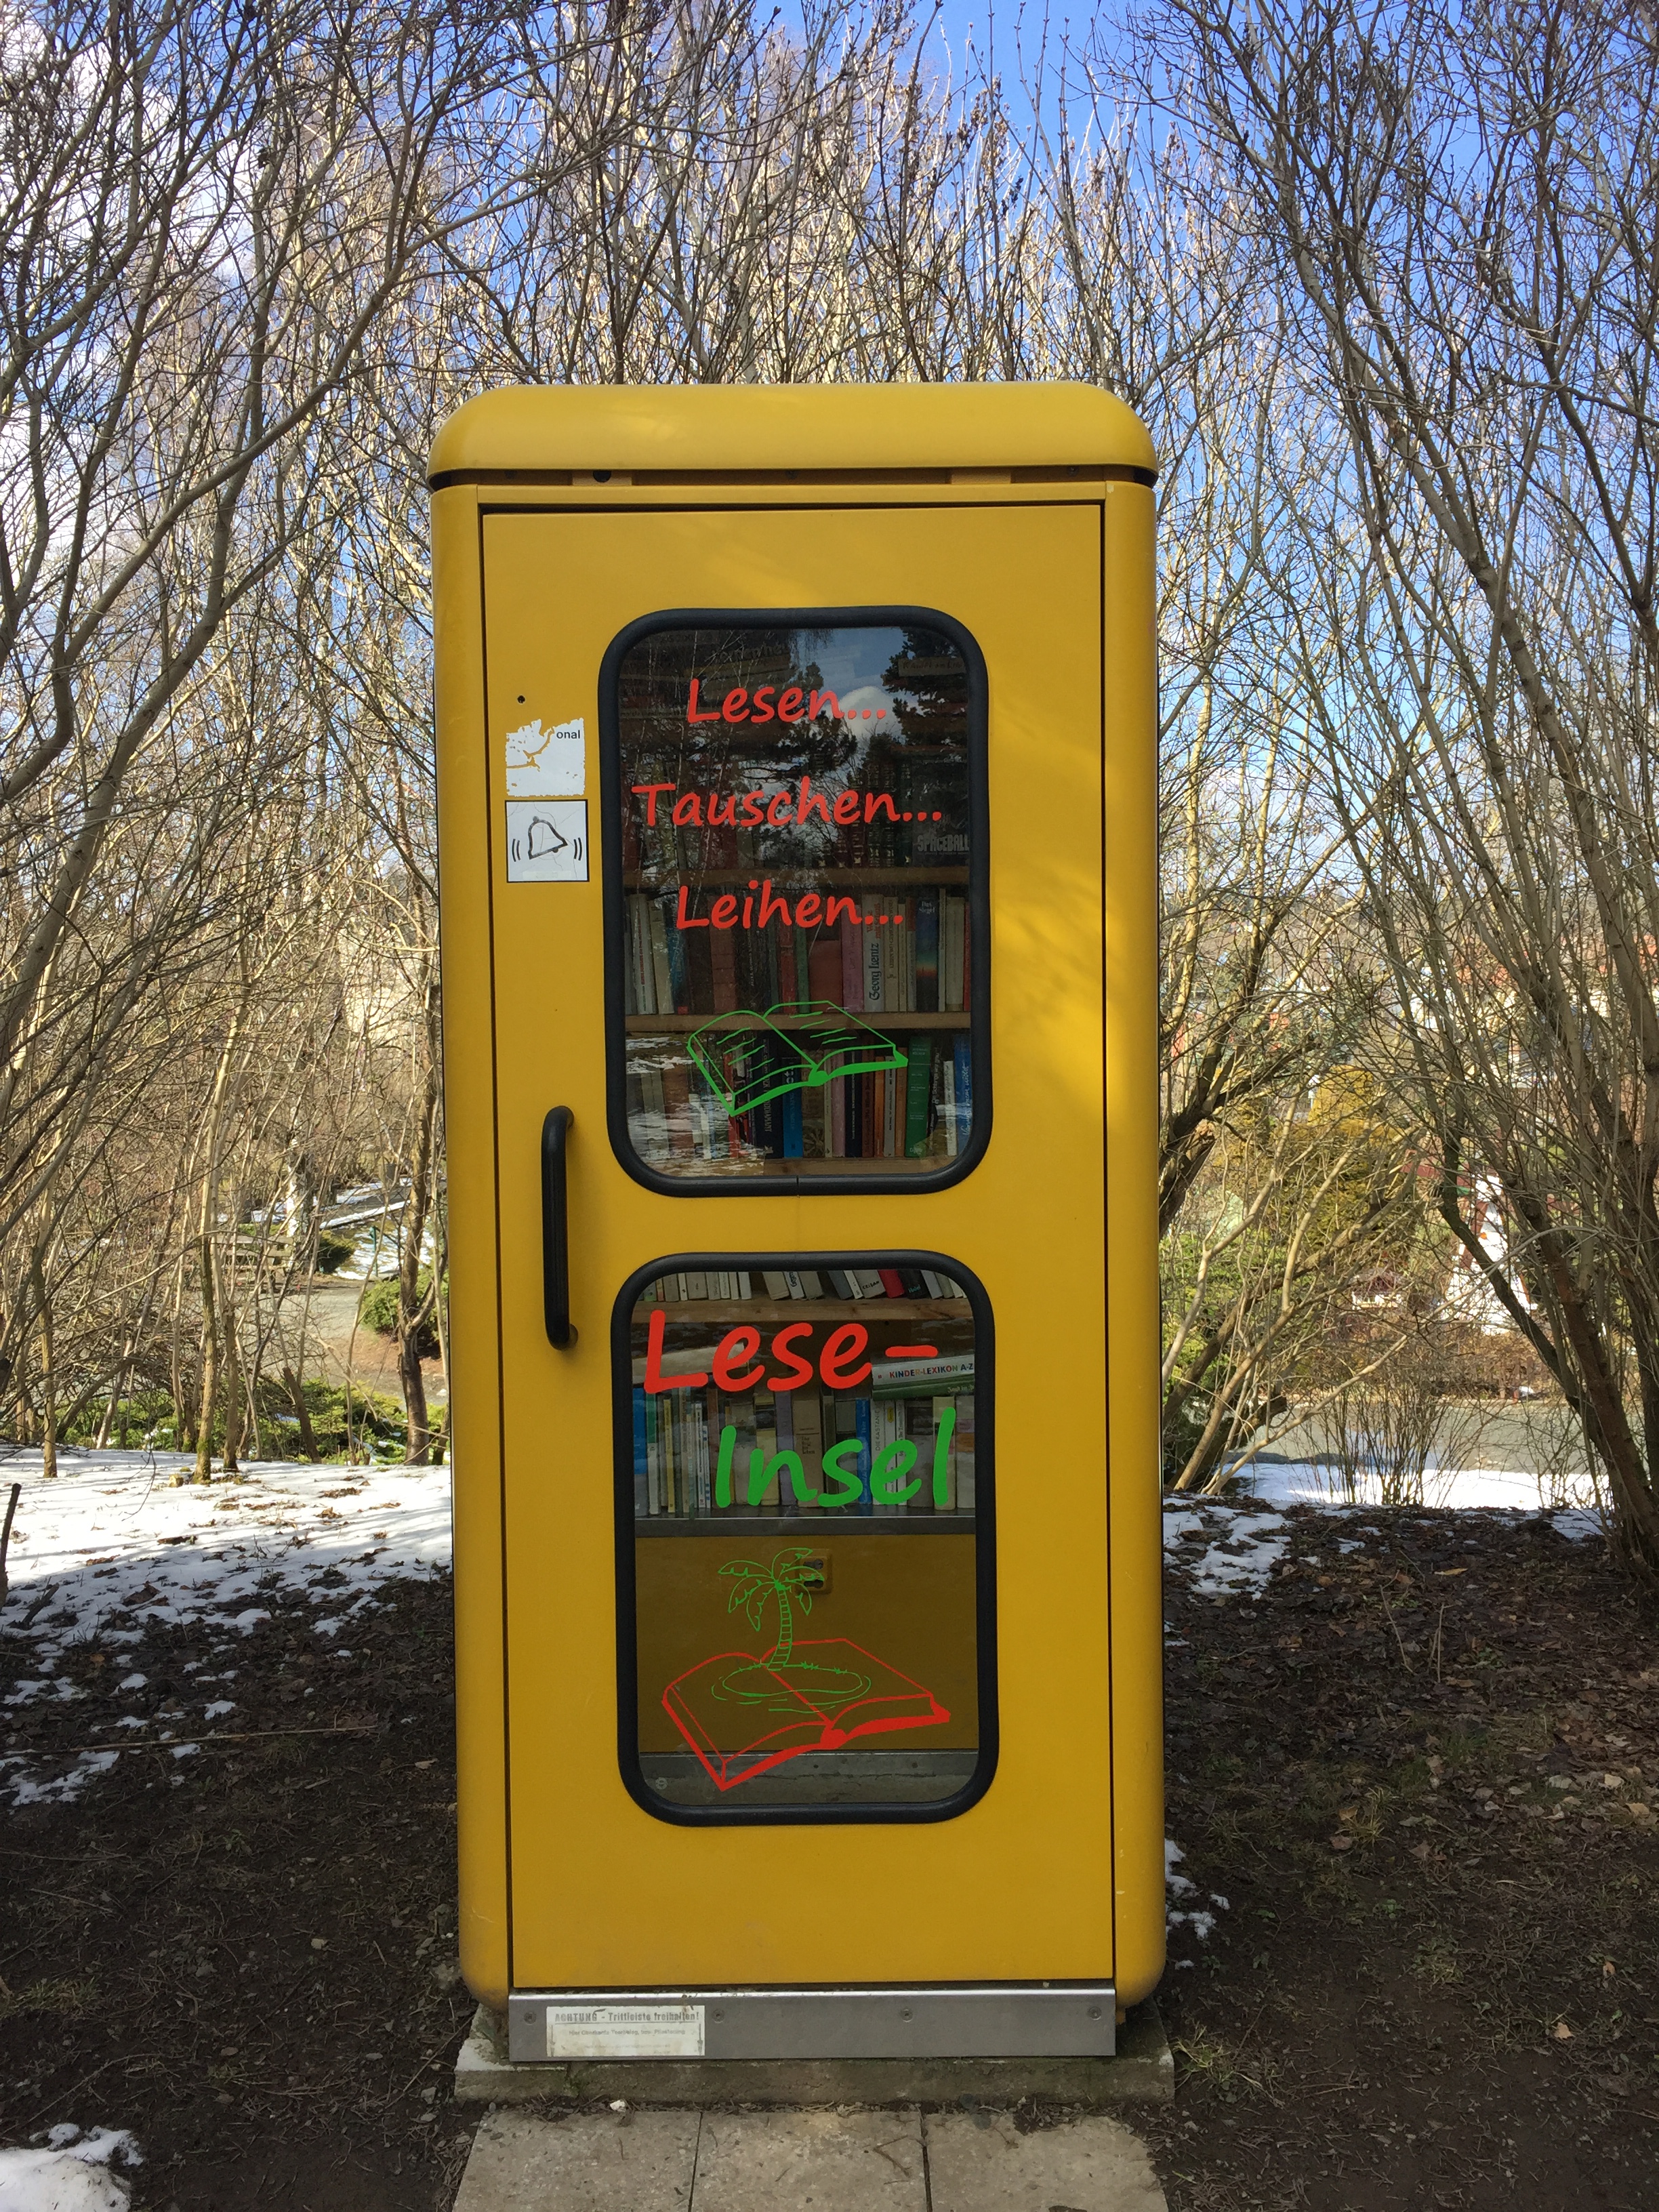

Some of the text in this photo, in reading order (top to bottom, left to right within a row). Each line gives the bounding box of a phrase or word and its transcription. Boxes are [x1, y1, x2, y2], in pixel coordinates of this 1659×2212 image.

[688, 679, 886, 724] Lesen...
[632, 776, 941, 827] Tauschen...
[676, 880, 903, 930] Leihen...
[869, 970, 882, 1001] Georg
[644, 1310, 938, 1393] Lese-
[889, 1362, 973, 1379] KINDER-LEXIKON A-Z
[715, 1406, 957, 1509] Insel
[554, 2012, 598, 2022] ACHTUNG
[608, 2012, 651, 2022] Trittleiste
[654, 2011, 699, 2021] freihalten!
